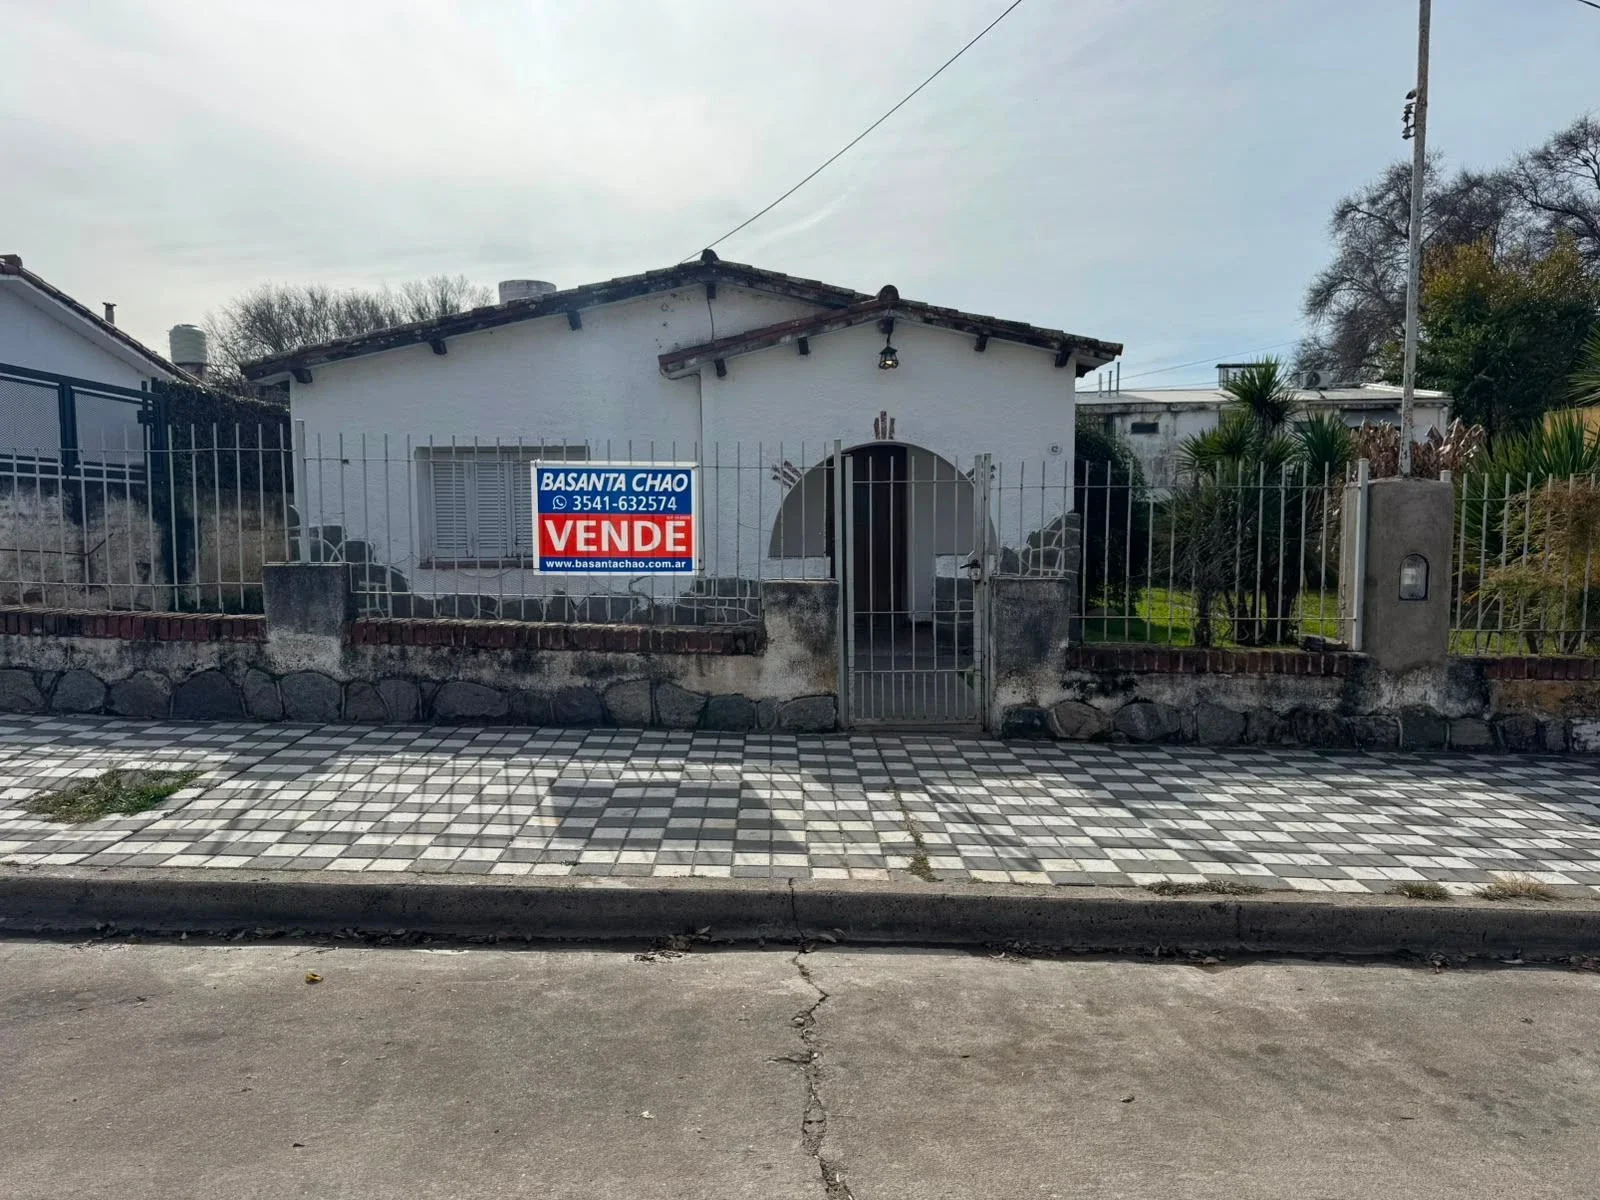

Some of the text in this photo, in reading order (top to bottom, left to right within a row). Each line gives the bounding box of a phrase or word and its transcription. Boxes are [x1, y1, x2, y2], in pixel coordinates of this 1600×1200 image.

[541, 473, 688, 492] BASANTA CHAO
[573, 495, 677, 511] 3541-632574
[545, 520, 686, 552] VENDE
[546, 559, 686, 568] www.basantachao.com.ar
